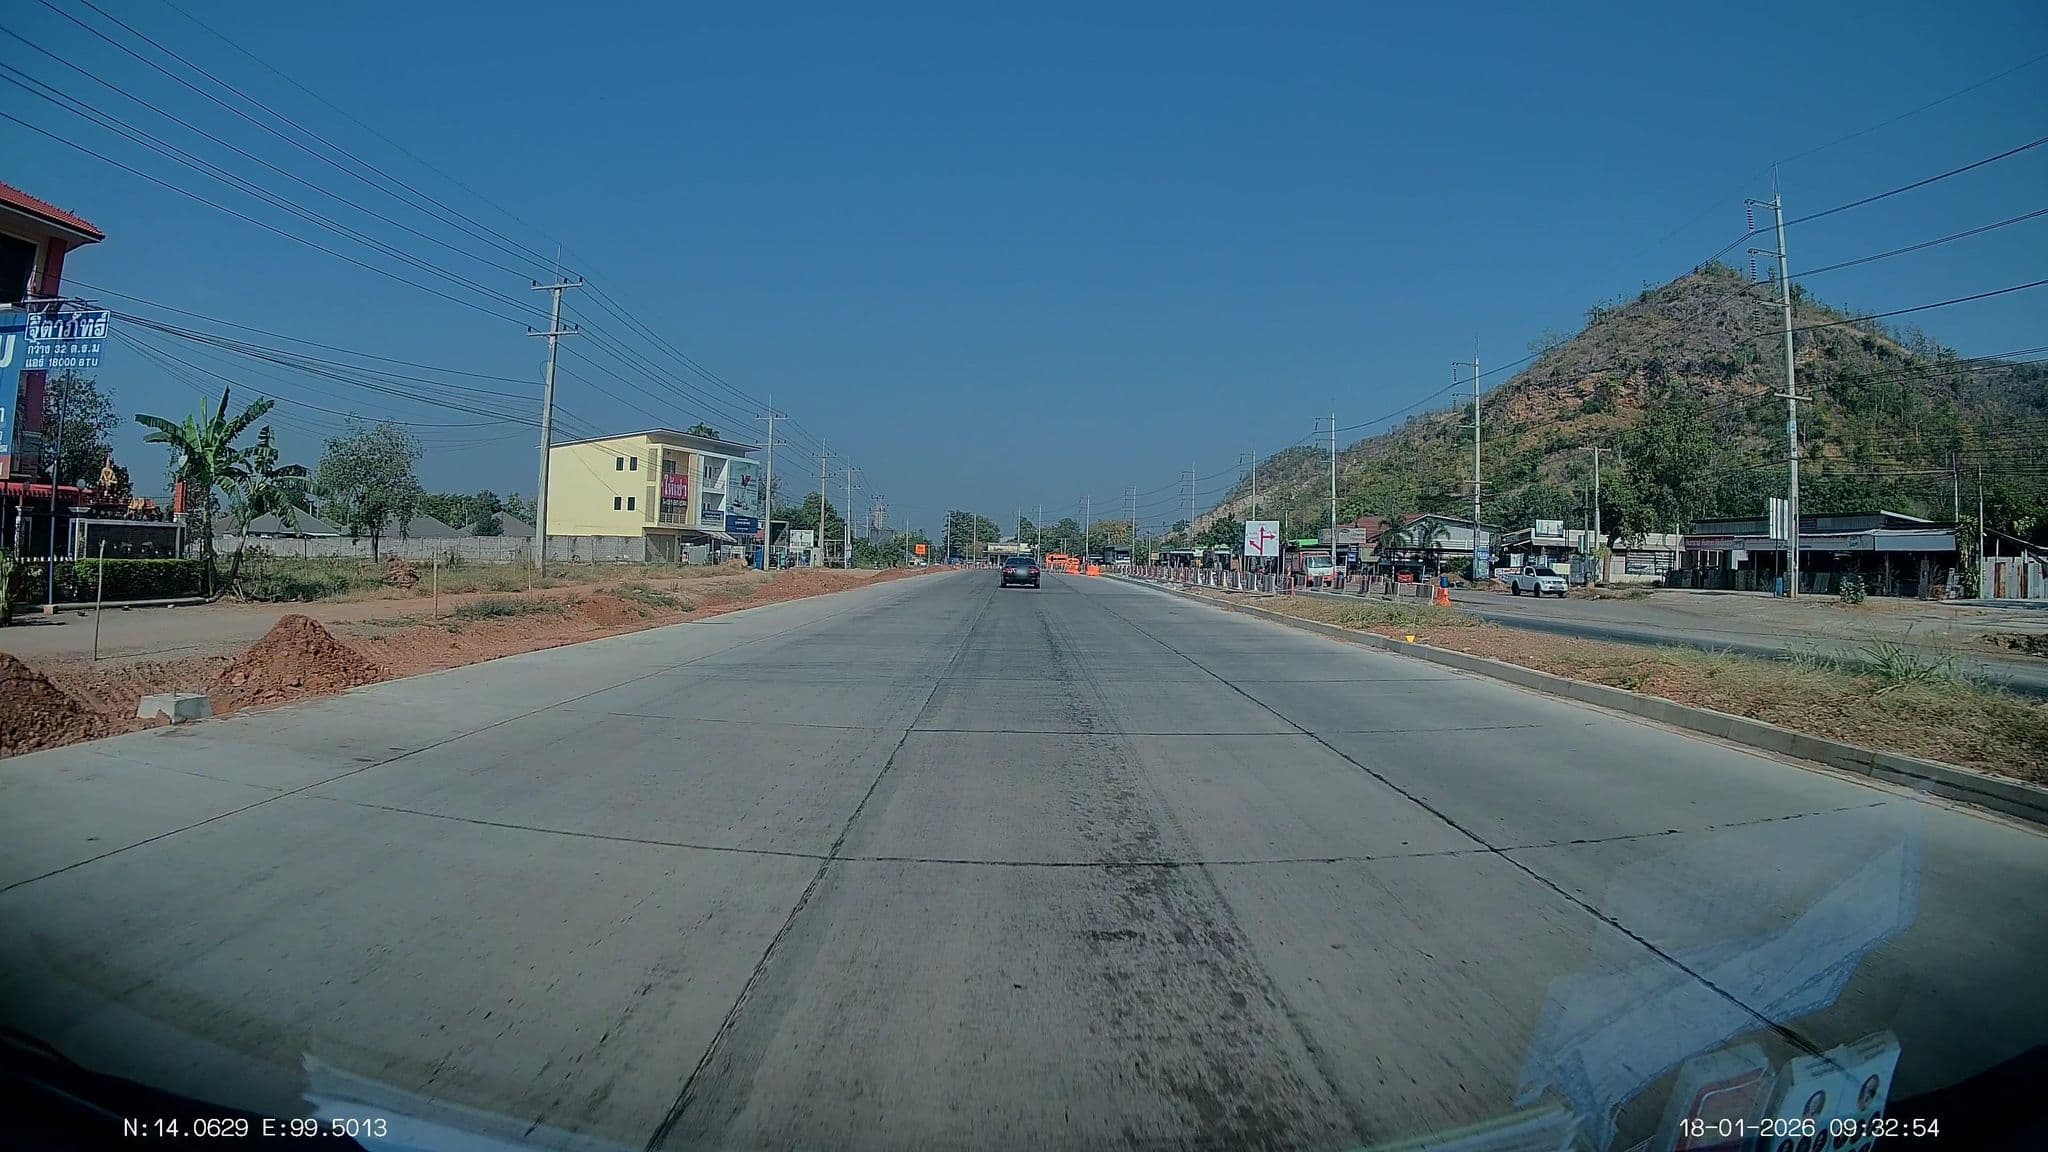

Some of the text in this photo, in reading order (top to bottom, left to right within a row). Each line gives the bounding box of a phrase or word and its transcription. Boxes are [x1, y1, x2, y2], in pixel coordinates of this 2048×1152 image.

[27, 341, 51, 355] กว้าง
[54, 344, 67, 354] 32
[25, 355, 98, 368] แอร์ 18000 BTU
